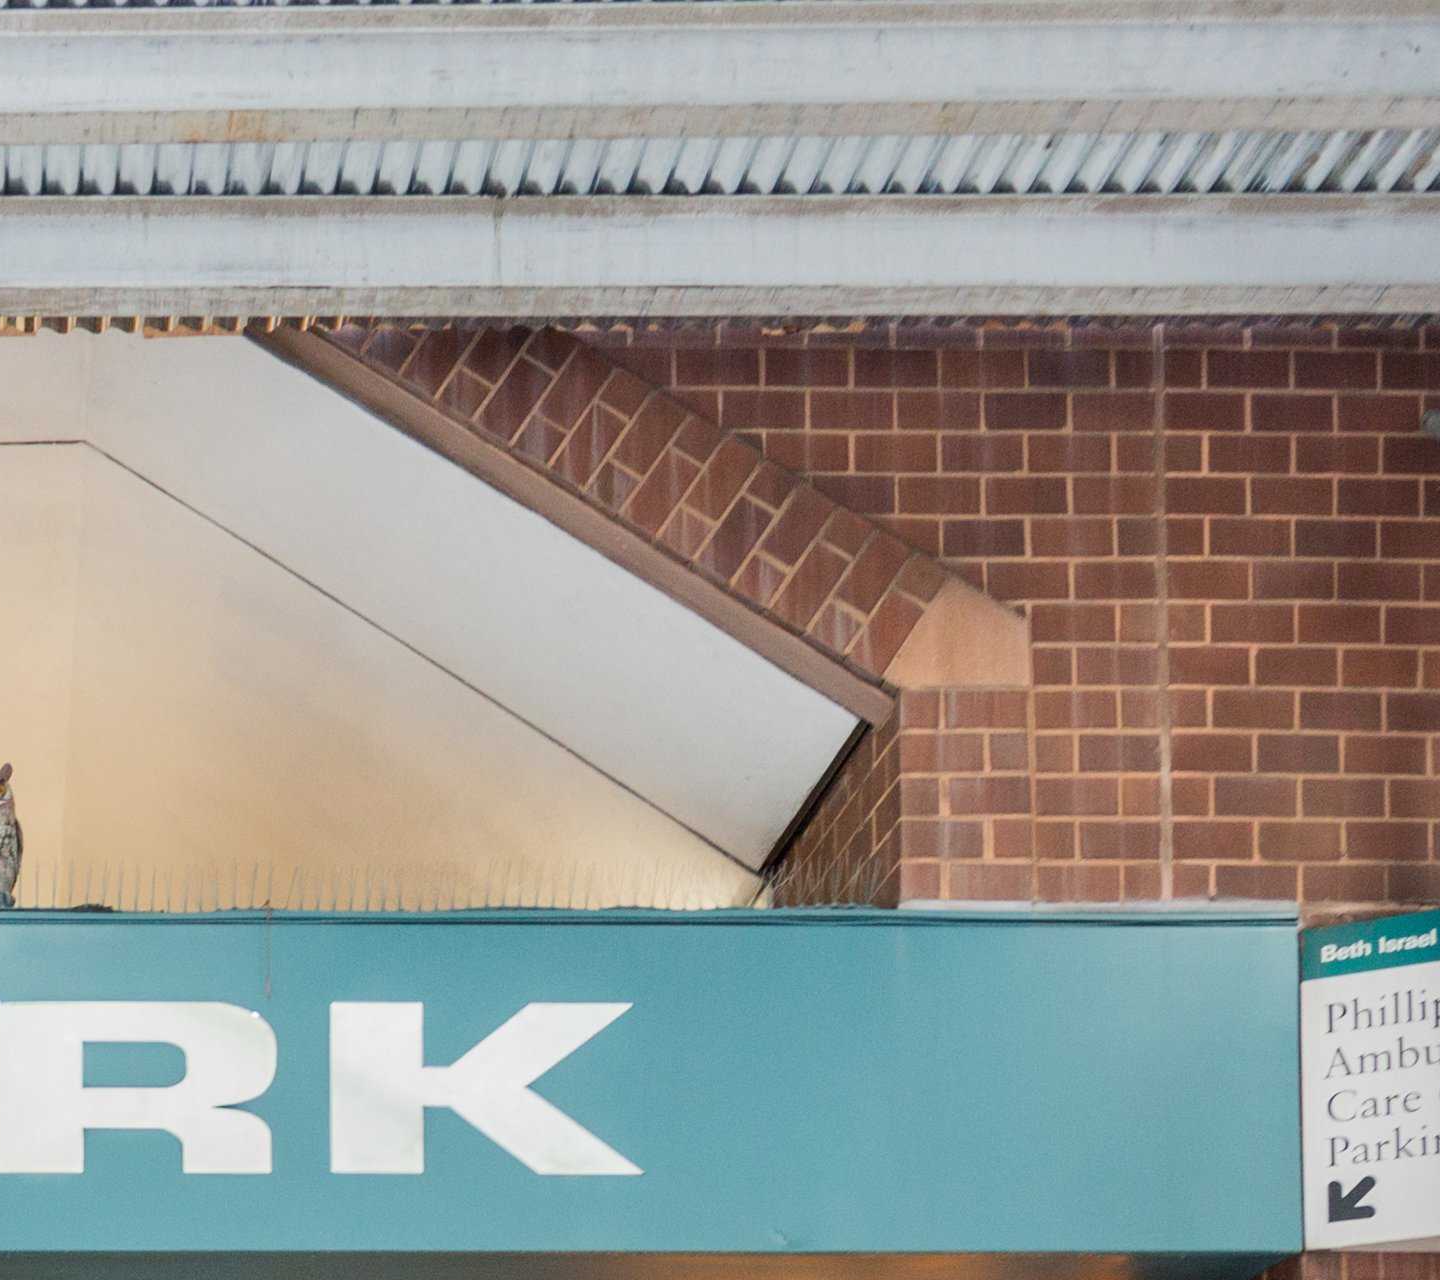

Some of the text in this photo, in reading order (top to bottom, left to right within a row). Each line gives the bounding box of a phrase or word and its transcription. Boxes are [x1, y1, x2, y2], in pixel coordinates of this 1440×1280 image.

[1320, 938, 1372, 964] Beth
[1377, 928, 1438, 955] Israel
[1326, 1089, 1422, 1123] Care
